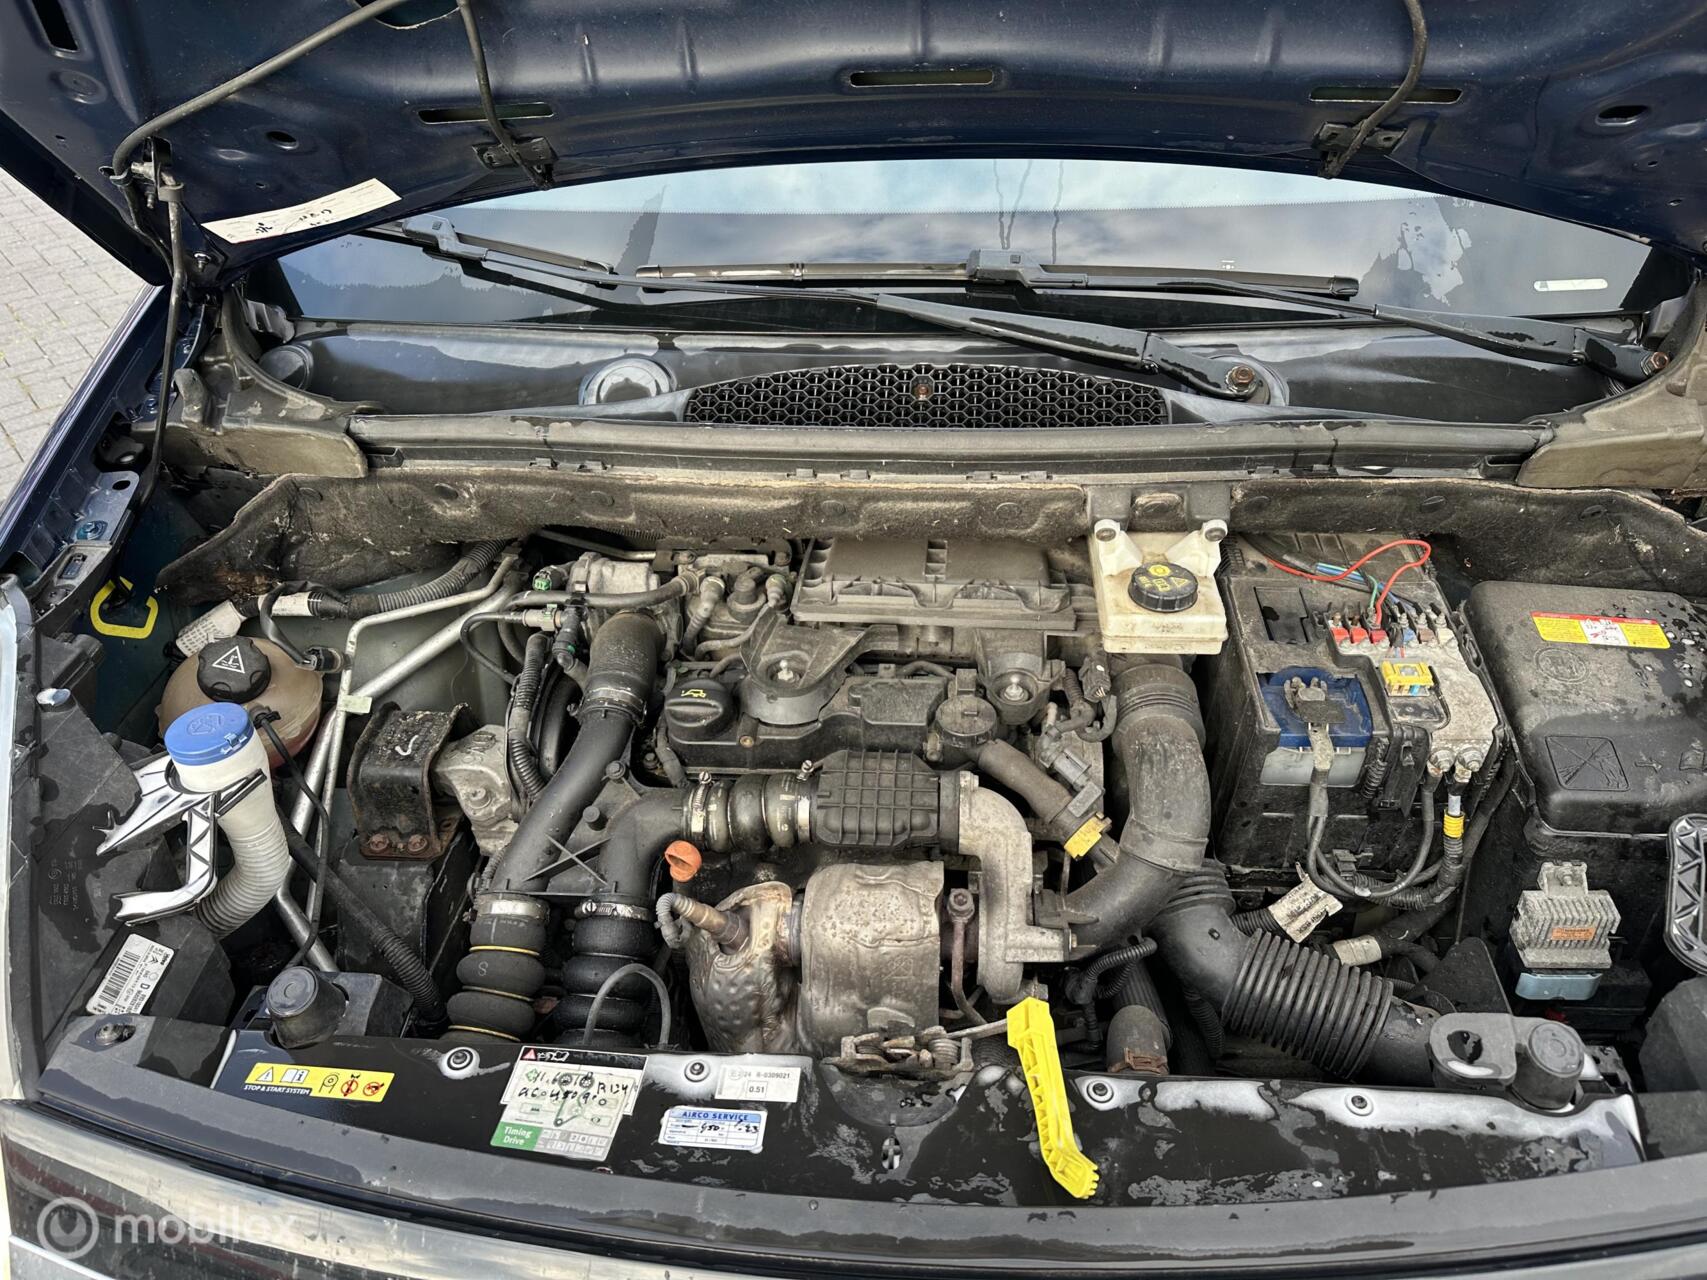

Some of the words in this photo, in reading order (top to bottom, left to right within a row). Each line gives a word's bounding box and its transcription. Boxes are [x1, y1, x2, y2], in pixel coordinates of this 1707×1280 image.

[682, 1111, 709, 1119] AIRCO
[712, 1112, 749, 1121] SERVICE
[504, 1126, 532, 1138] Timing
[503, 1135, 525, 1146] Drive
